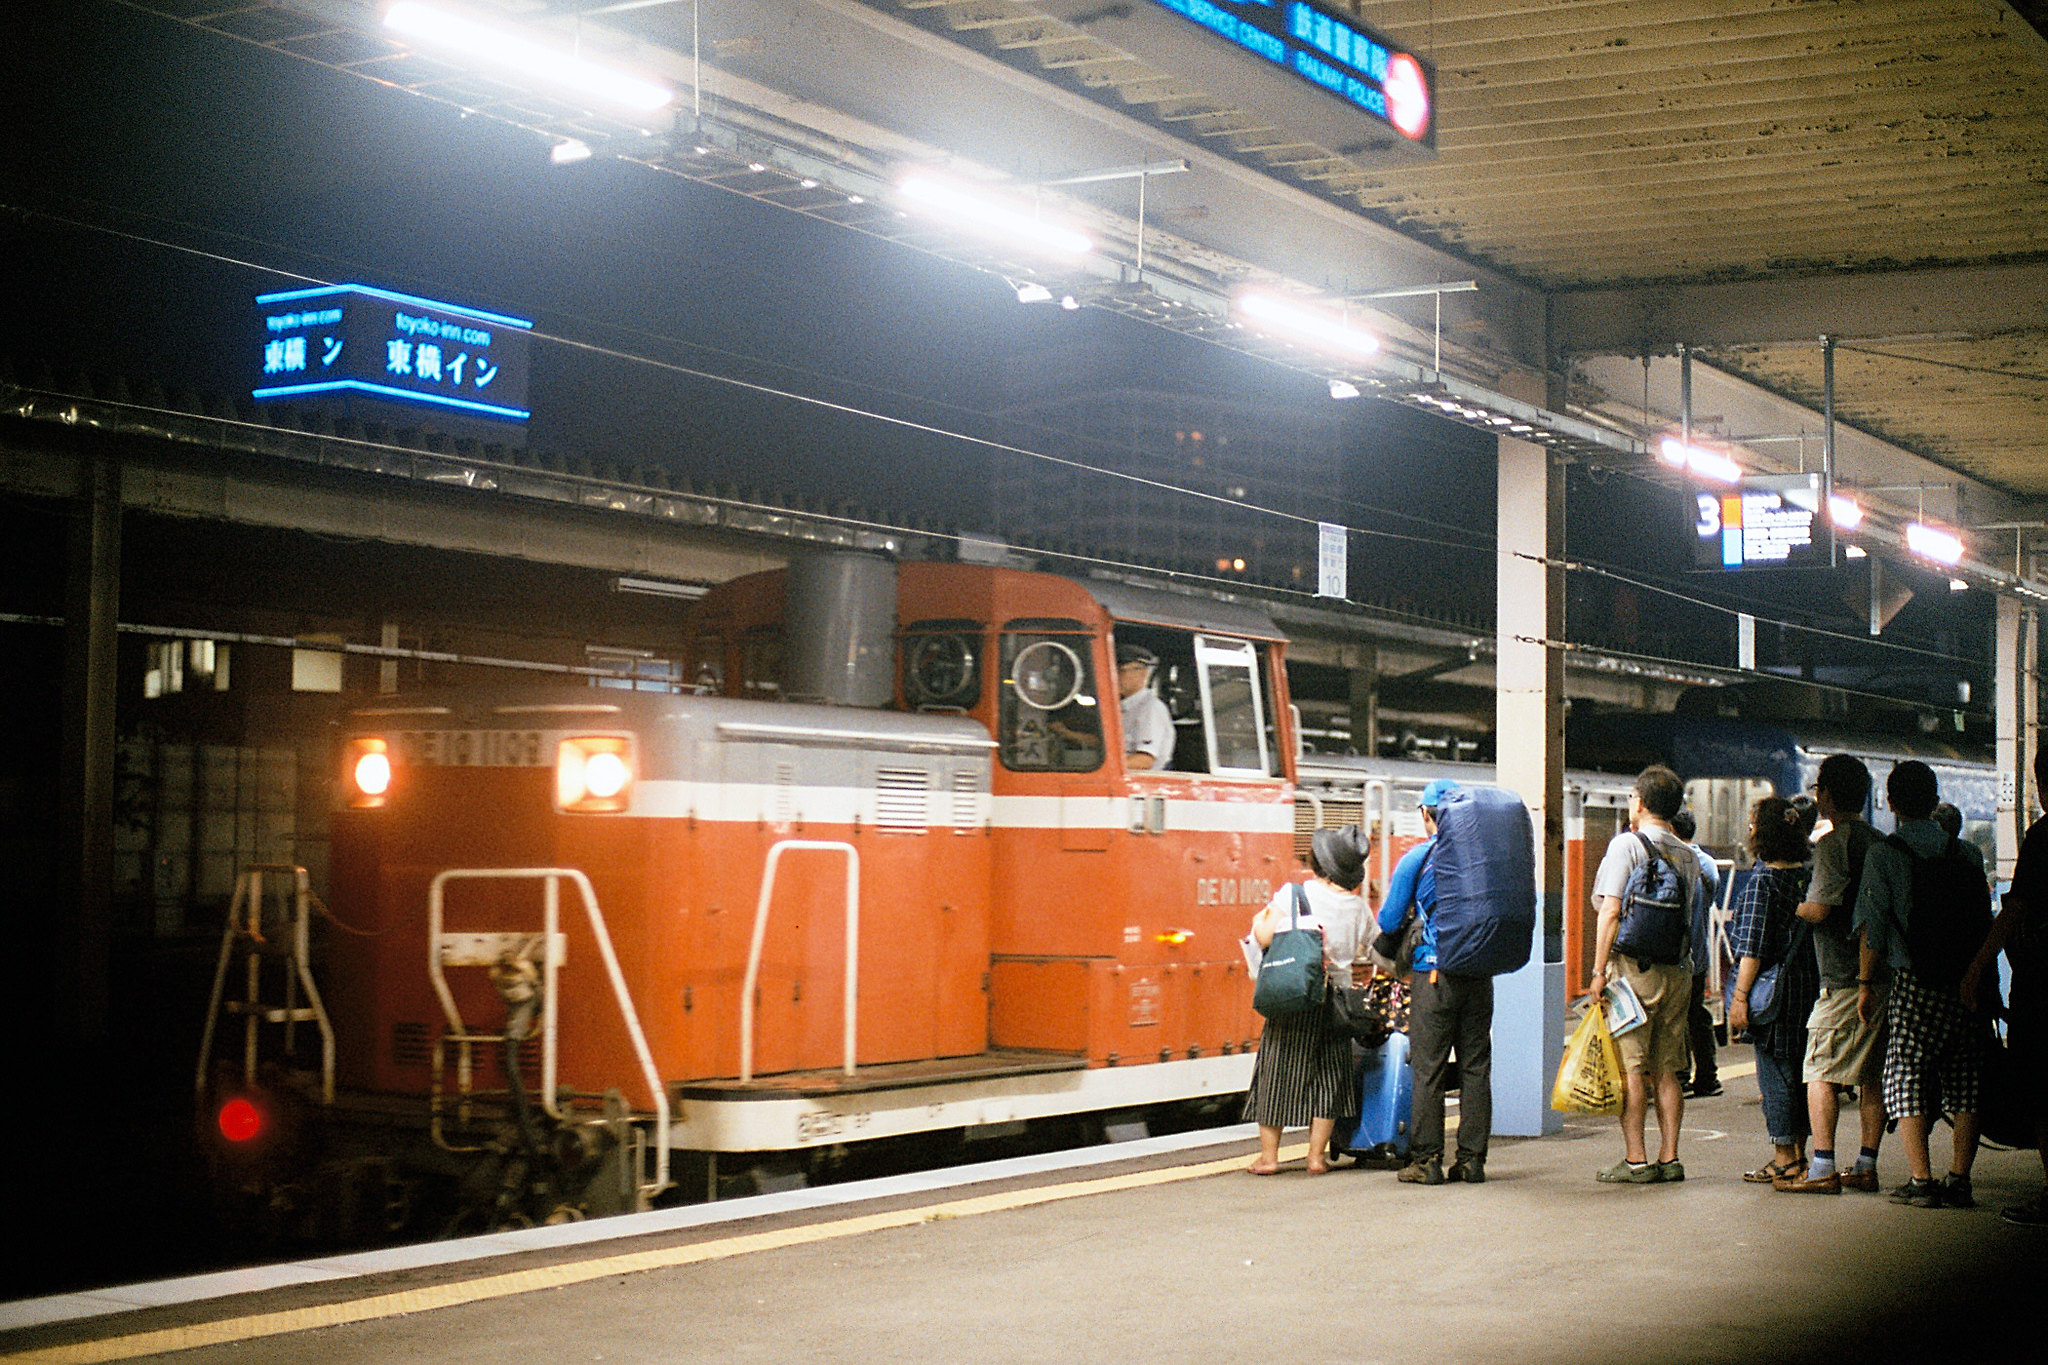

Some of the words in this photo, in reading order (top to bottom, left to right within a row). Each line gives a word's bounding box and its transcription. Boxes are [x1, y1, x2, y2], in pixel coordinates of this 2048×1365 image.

[396, 312, 491, 347] toyoko-inn.com
[387, 339, 497, 388] 東横イン
[1697, 494, 1720, 536] 3
